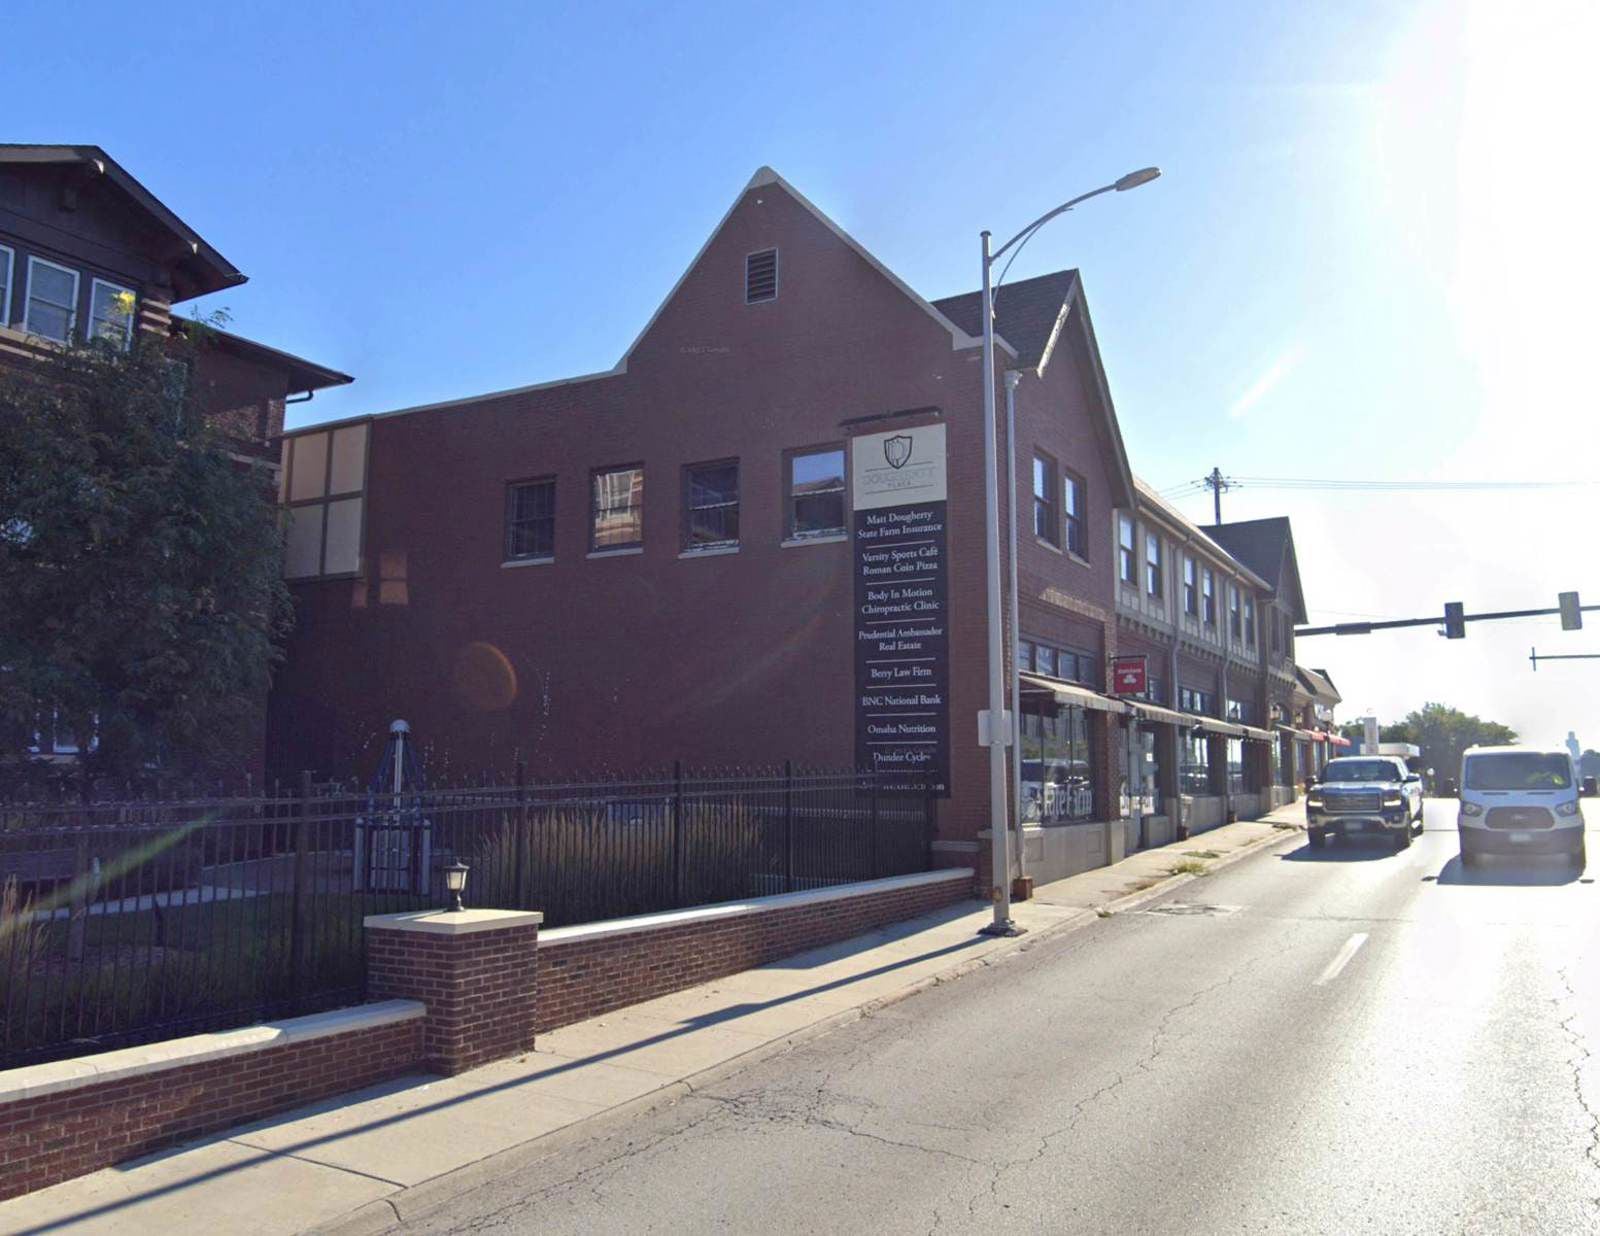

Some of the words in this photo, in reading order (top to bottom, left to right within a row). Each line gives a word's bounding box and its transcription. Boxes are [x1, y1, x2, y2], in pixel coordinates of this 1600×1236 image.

[867, 514, 886, 525] Matt
[888, 511, 933, 523] Dougherty
[857, 529, 878, 539] State
[879, 527, 900, 537] Farm
[902, 523, 942, 534] Insurance
[890, 550, 917, 561] Sports
[863, 565, 892, 576] Roman
[893, 563, 914, 572] Coin
[916, 561, 938, 571] Pizza
[867, 590, 888, 601] Body
[890, 589, 900, 599] In
[901, 588, 933, 598] Motion
[861, 603, 912, 615] Chiropractic
[913, 600, 940, 610] Clinic
[858, 629, 896, 640] Prudential
[897, 626, 943, 637] Ambassador
[879, 642, 896, 651] Real
[897, 641, 922, 650] Estate
[871, 668, 893, 679] Berry
[893, 667, 910, 677] Law
[912, 666, 932, 676] Firm
[862, 696, 883, 706] BNC
[884, 695, 919, 705] National
[920, 694, 941, 705] Bank
[867, 724, 897, 734] Omaha
[898, 723, 936, 733] Nutrition
